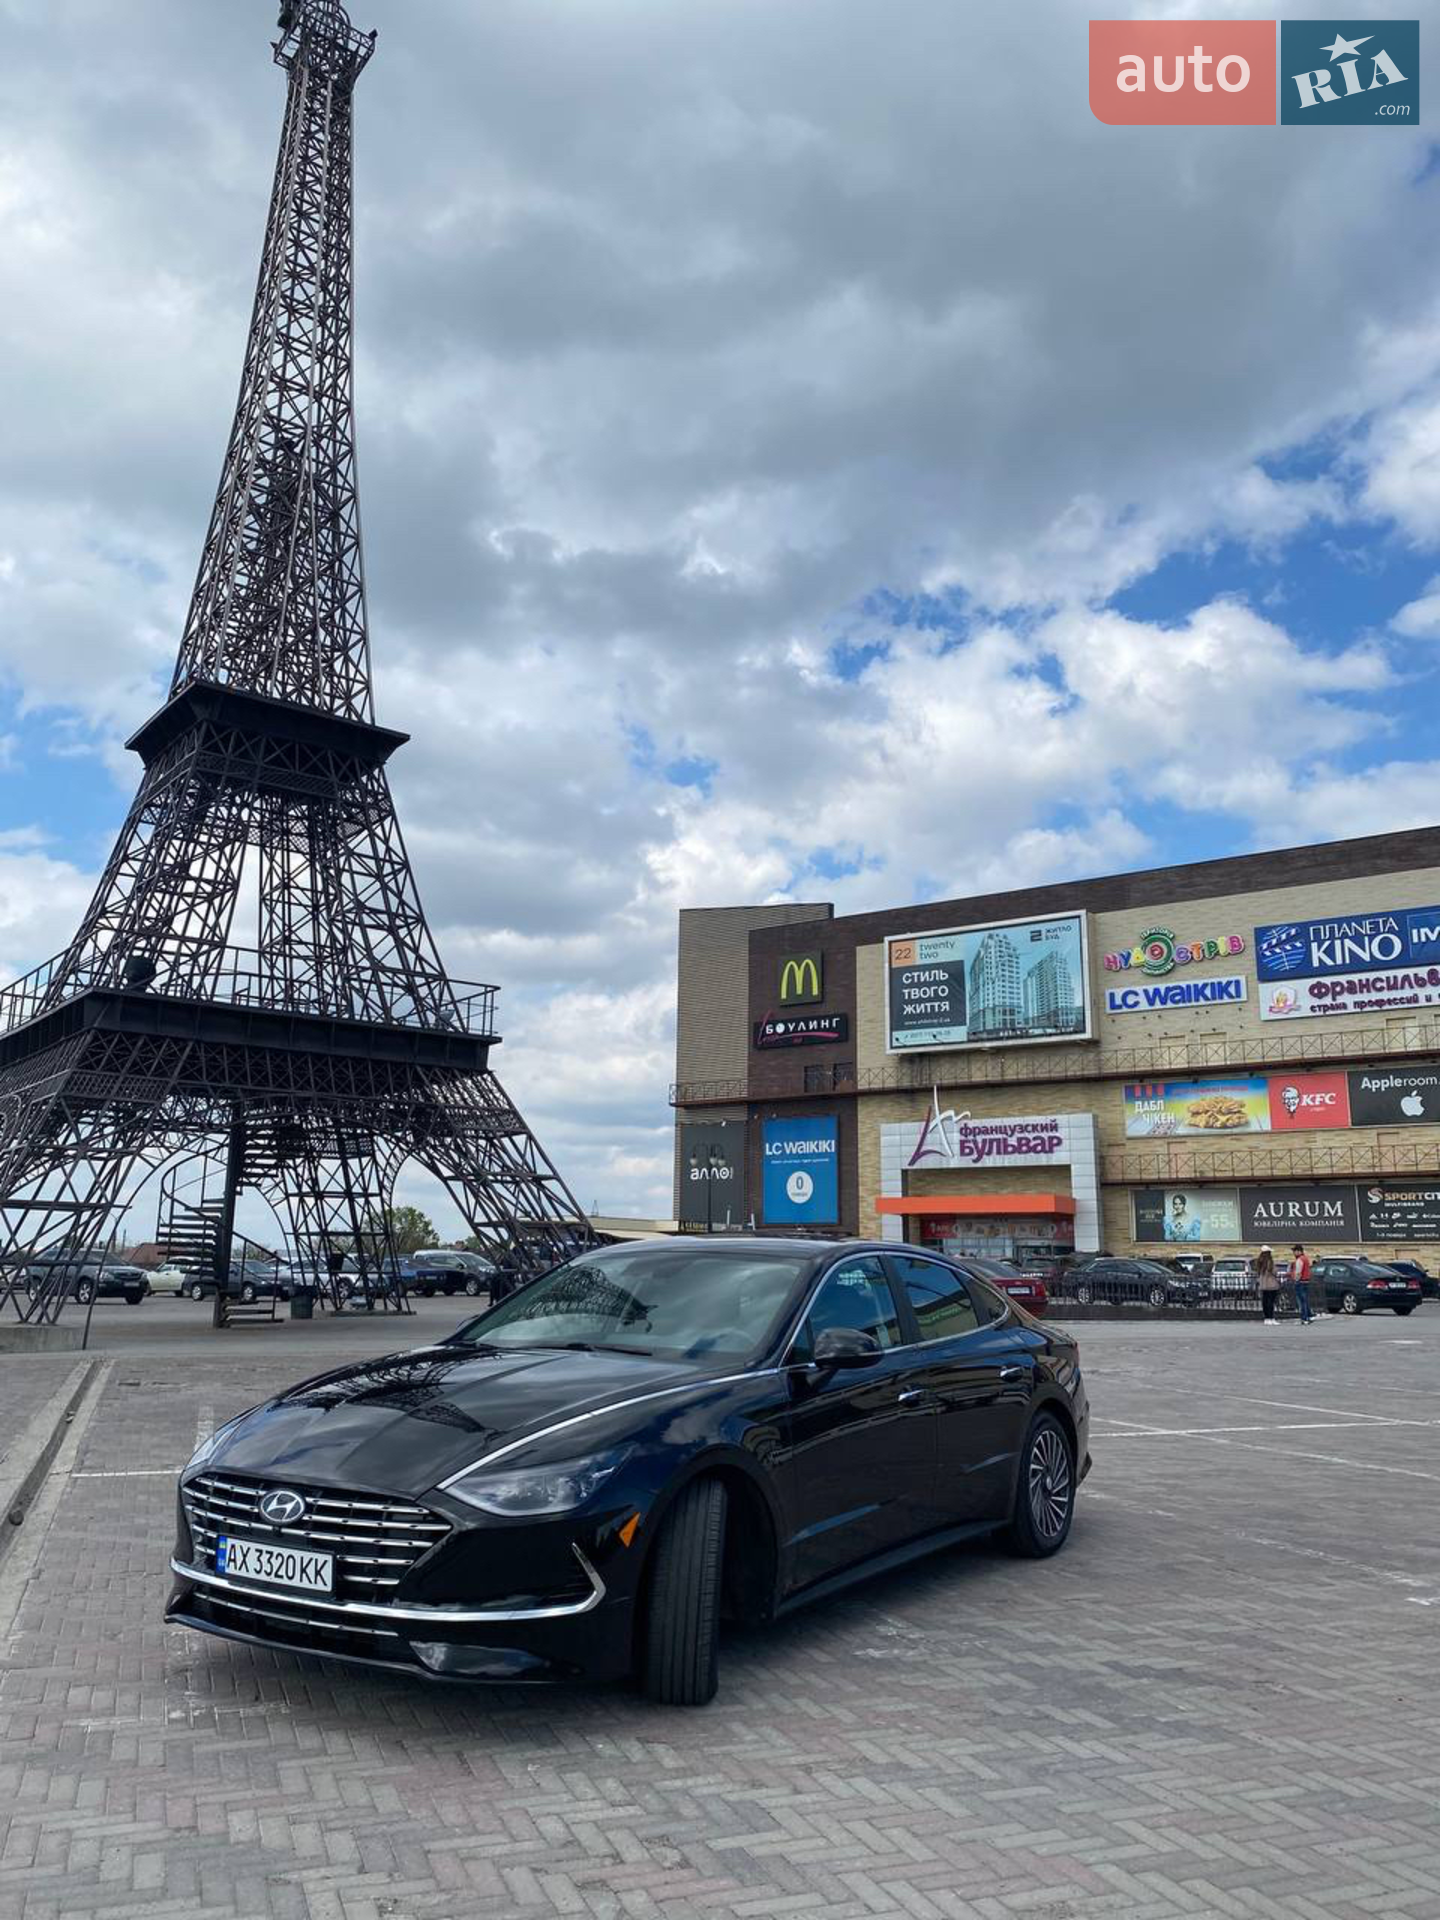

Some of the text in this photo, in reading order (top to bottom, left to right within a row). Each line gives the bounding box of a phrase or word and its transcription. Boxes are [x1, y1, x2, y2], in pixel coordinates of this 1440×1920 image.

[920, 941, 955, 952] twenty
[1311, 933, 1402, 967] KINO
[895, 948, 911, 960] 22
[920, 951, 938, 960] two
[902, 969, 949, 984] СТИЛЬ
[902, 985, 949, 999] ТВОГО
[1109, 989, 1140, 1010] LC
[1310, 994, 1432, 1014] страна профессий и
[903, 1001, 950, 1015] ЖИТТЯ
[766, 1017, 840, 1034] БОУЛИНГ
[1135, 1099, 1164, 1113] ДАБЛ
[1300, 1093, 1336, 1106] KFC
[765, 1142, 782, 1155] LC
[1254, 1201, 1344, 1218] AURUM
[227, 1543, 328, 1586] AX 3320 KK
